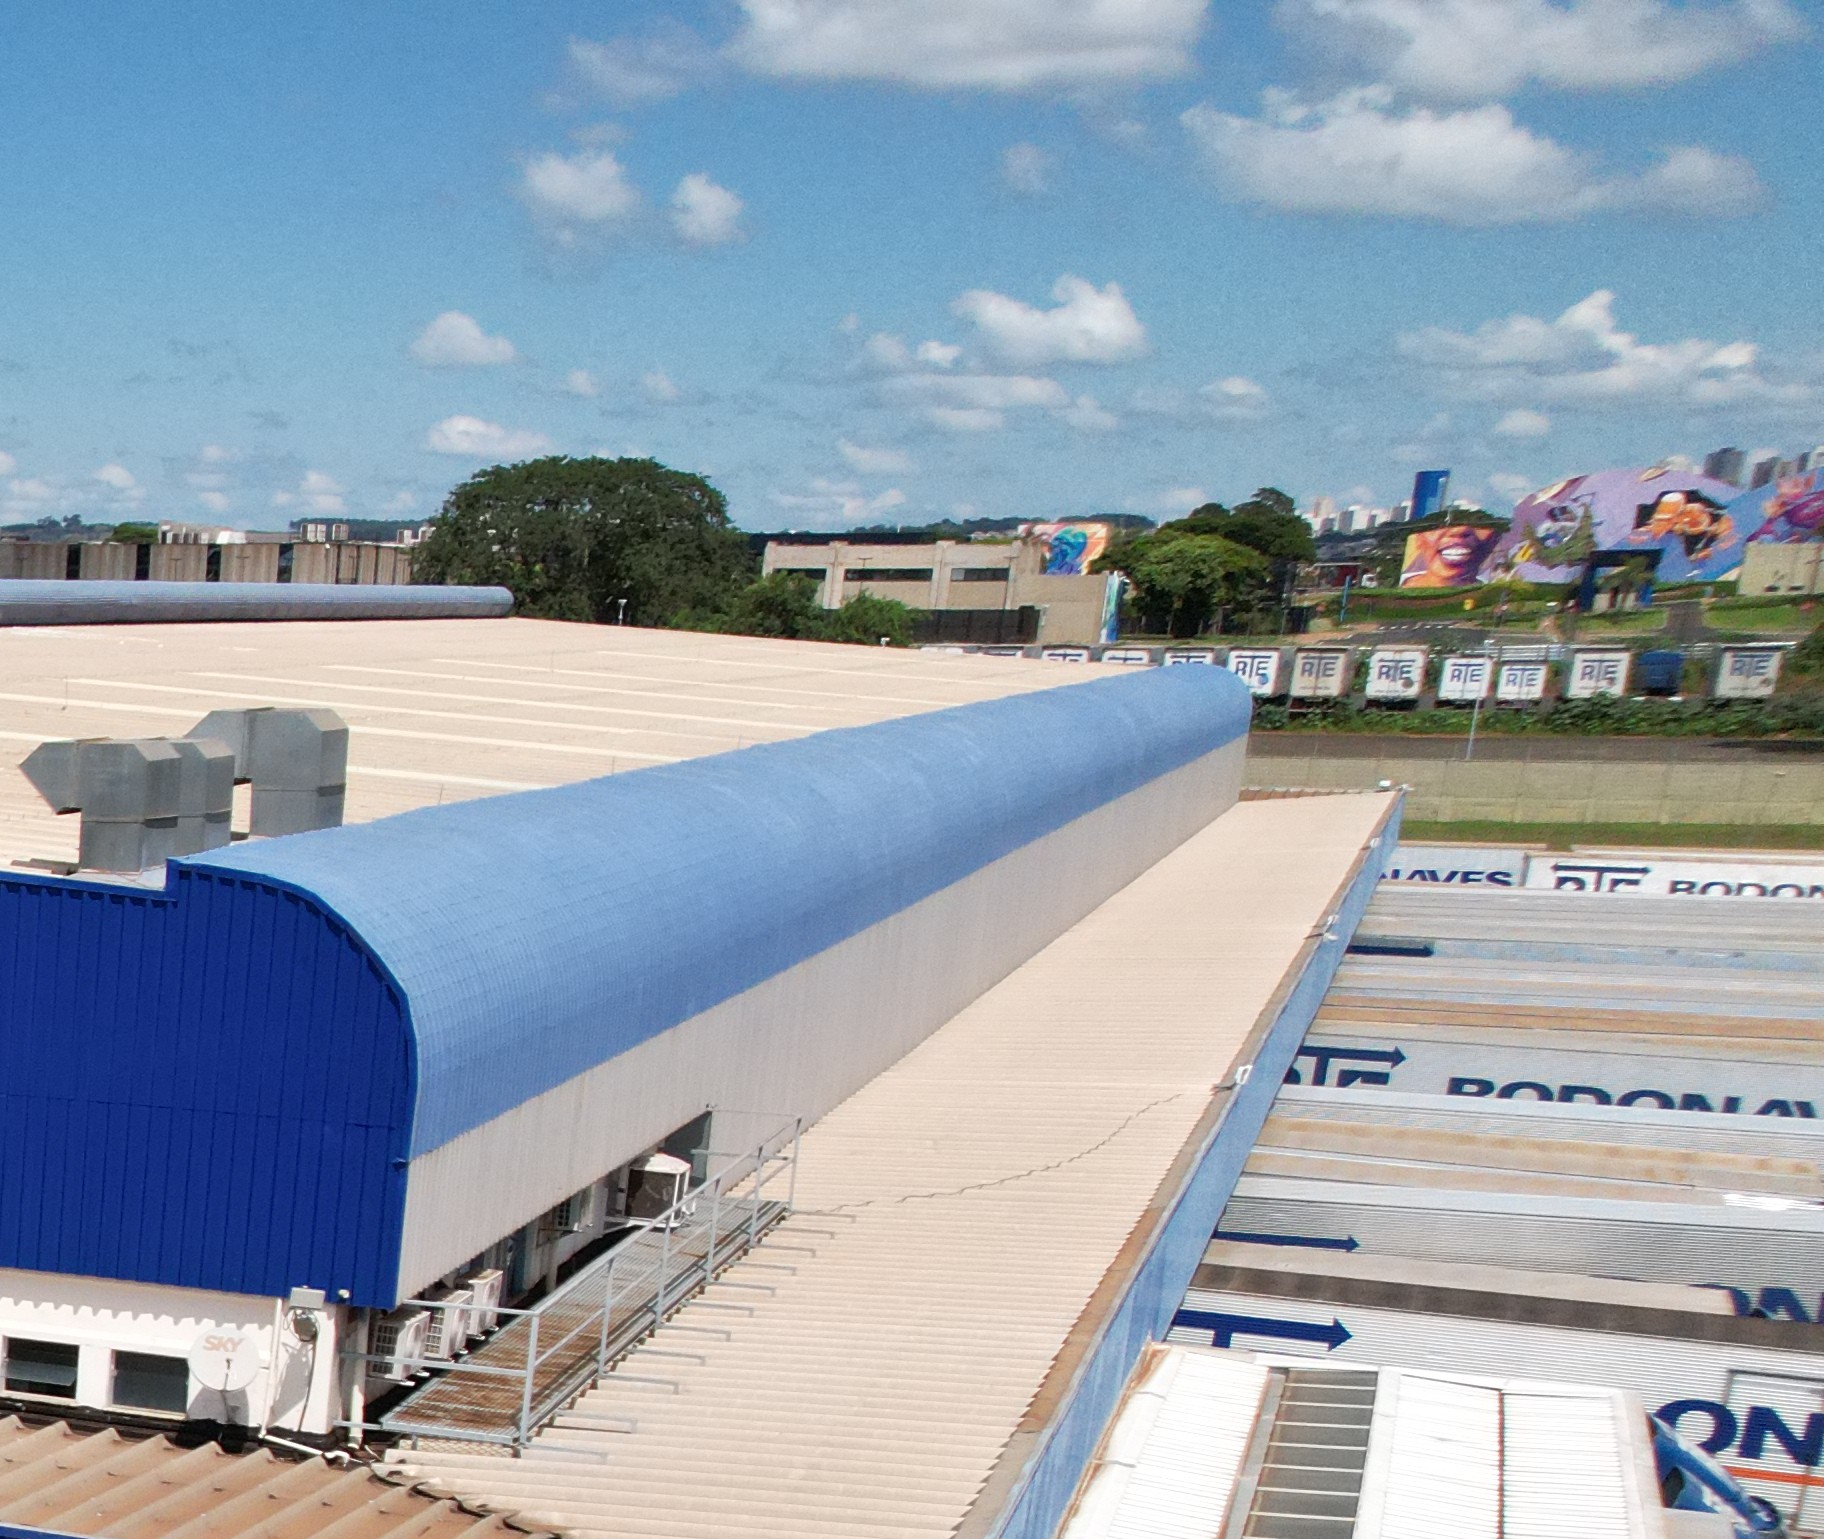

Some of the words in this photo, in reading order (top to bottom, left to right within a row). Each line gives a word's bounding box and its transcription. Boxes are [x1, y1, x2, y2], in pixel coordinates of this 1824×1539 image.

[1301, 655, 1339, 680] RTE
[1377, 659, 1416, 682] RTE
[1450, 663, 1486, 685] RTE
[1505, 667, 1539, 688] RTE
[1580, 659, 1620, 682] RTE
[1730, 653, 1772, 679] RTE
